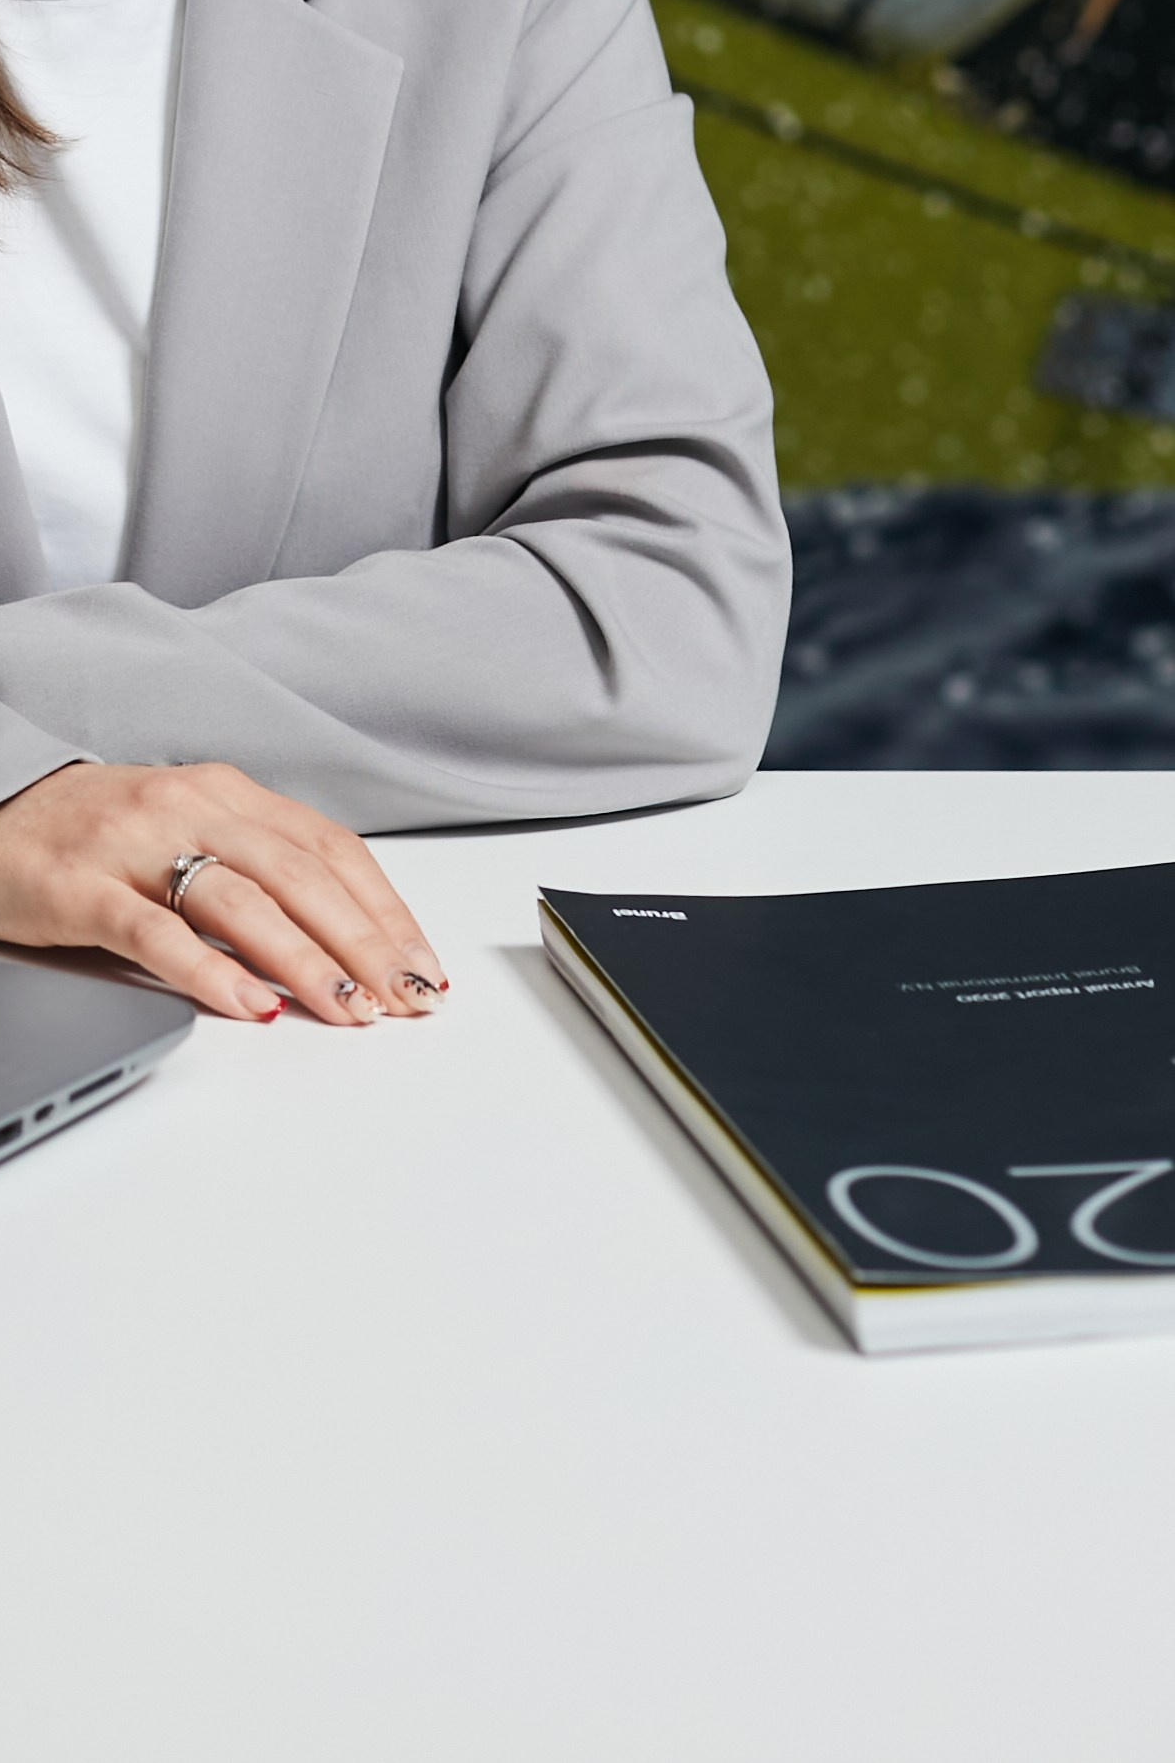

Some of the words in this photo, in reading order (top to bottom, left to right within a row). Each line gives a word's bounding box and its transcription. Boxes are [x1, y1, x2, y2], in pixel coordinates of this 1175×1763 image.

[612, 908, 688, 920] Brunel
[1072, 965, 1142, 979] Brunel
[937, 972, 1071, 989] International
[1082, 979, 1155, 993] Annual
[1015, 986, 1080, 999] report
